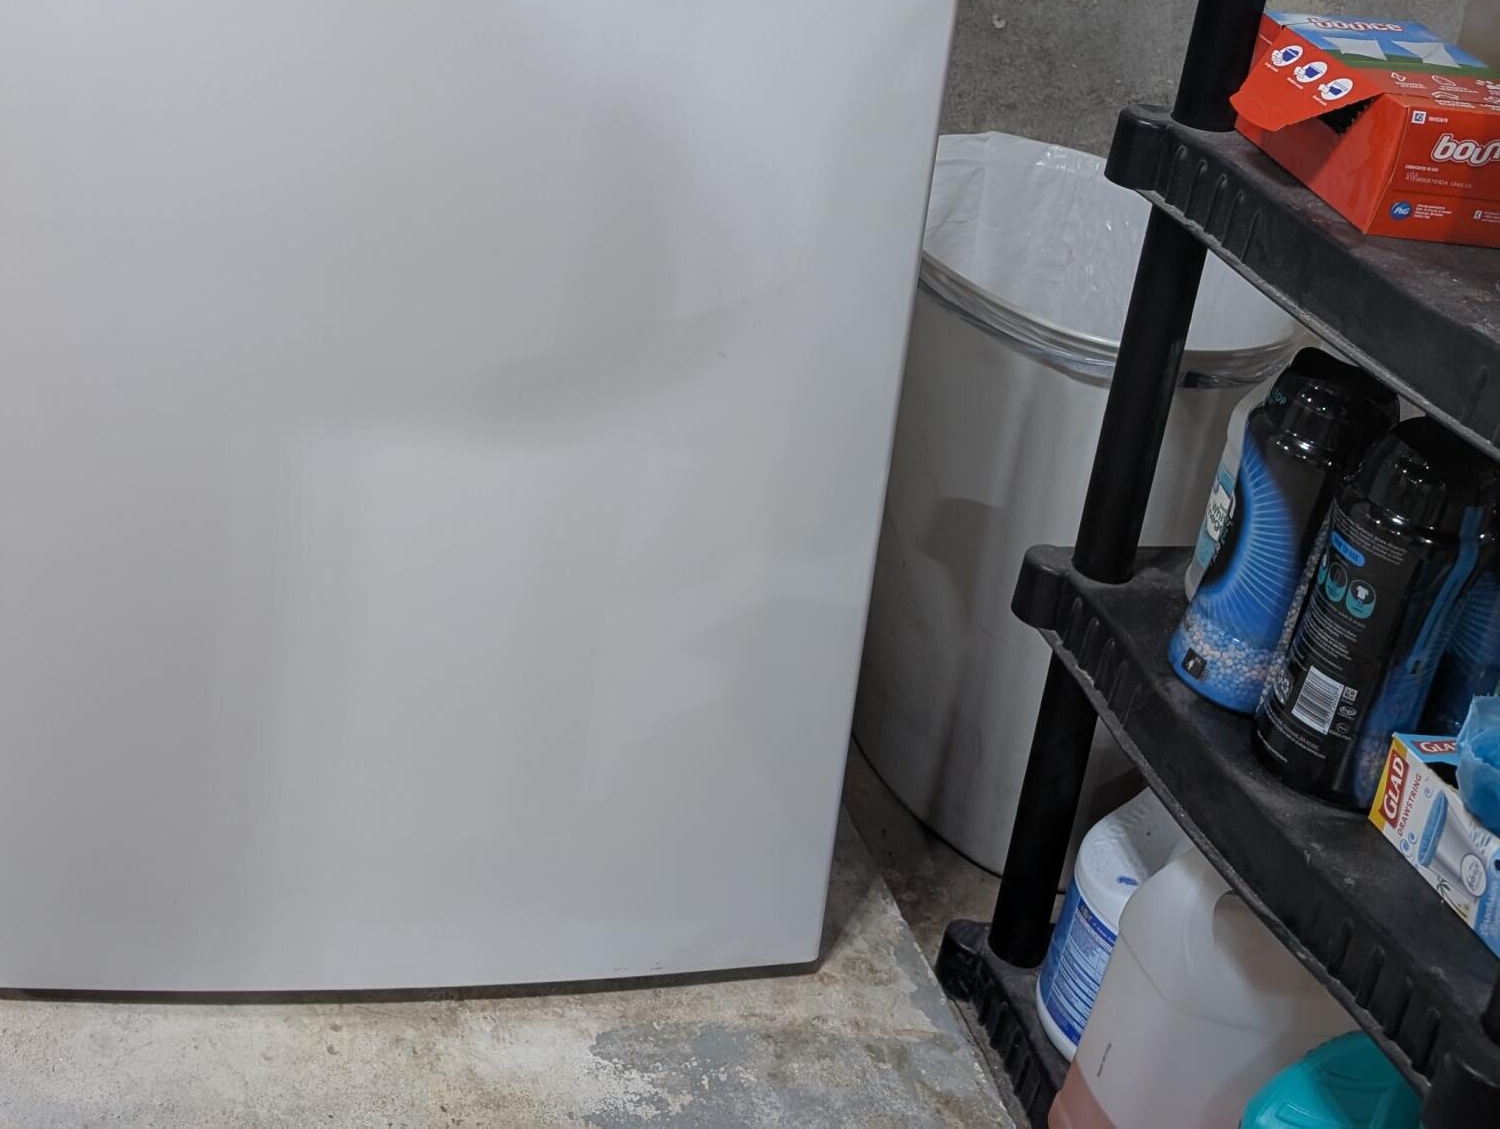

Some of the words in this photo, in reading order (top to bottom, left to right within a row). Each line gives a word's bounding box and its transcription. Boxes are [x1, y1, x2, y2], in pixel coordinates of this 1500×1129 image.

[1307, 17, 1404, 32] bounce
[1419, 742, 1457, 753] GLA
[1383, 755, 1404, 820] GLAD
[1397, 773, 1422, 837] DRAWSTRING
